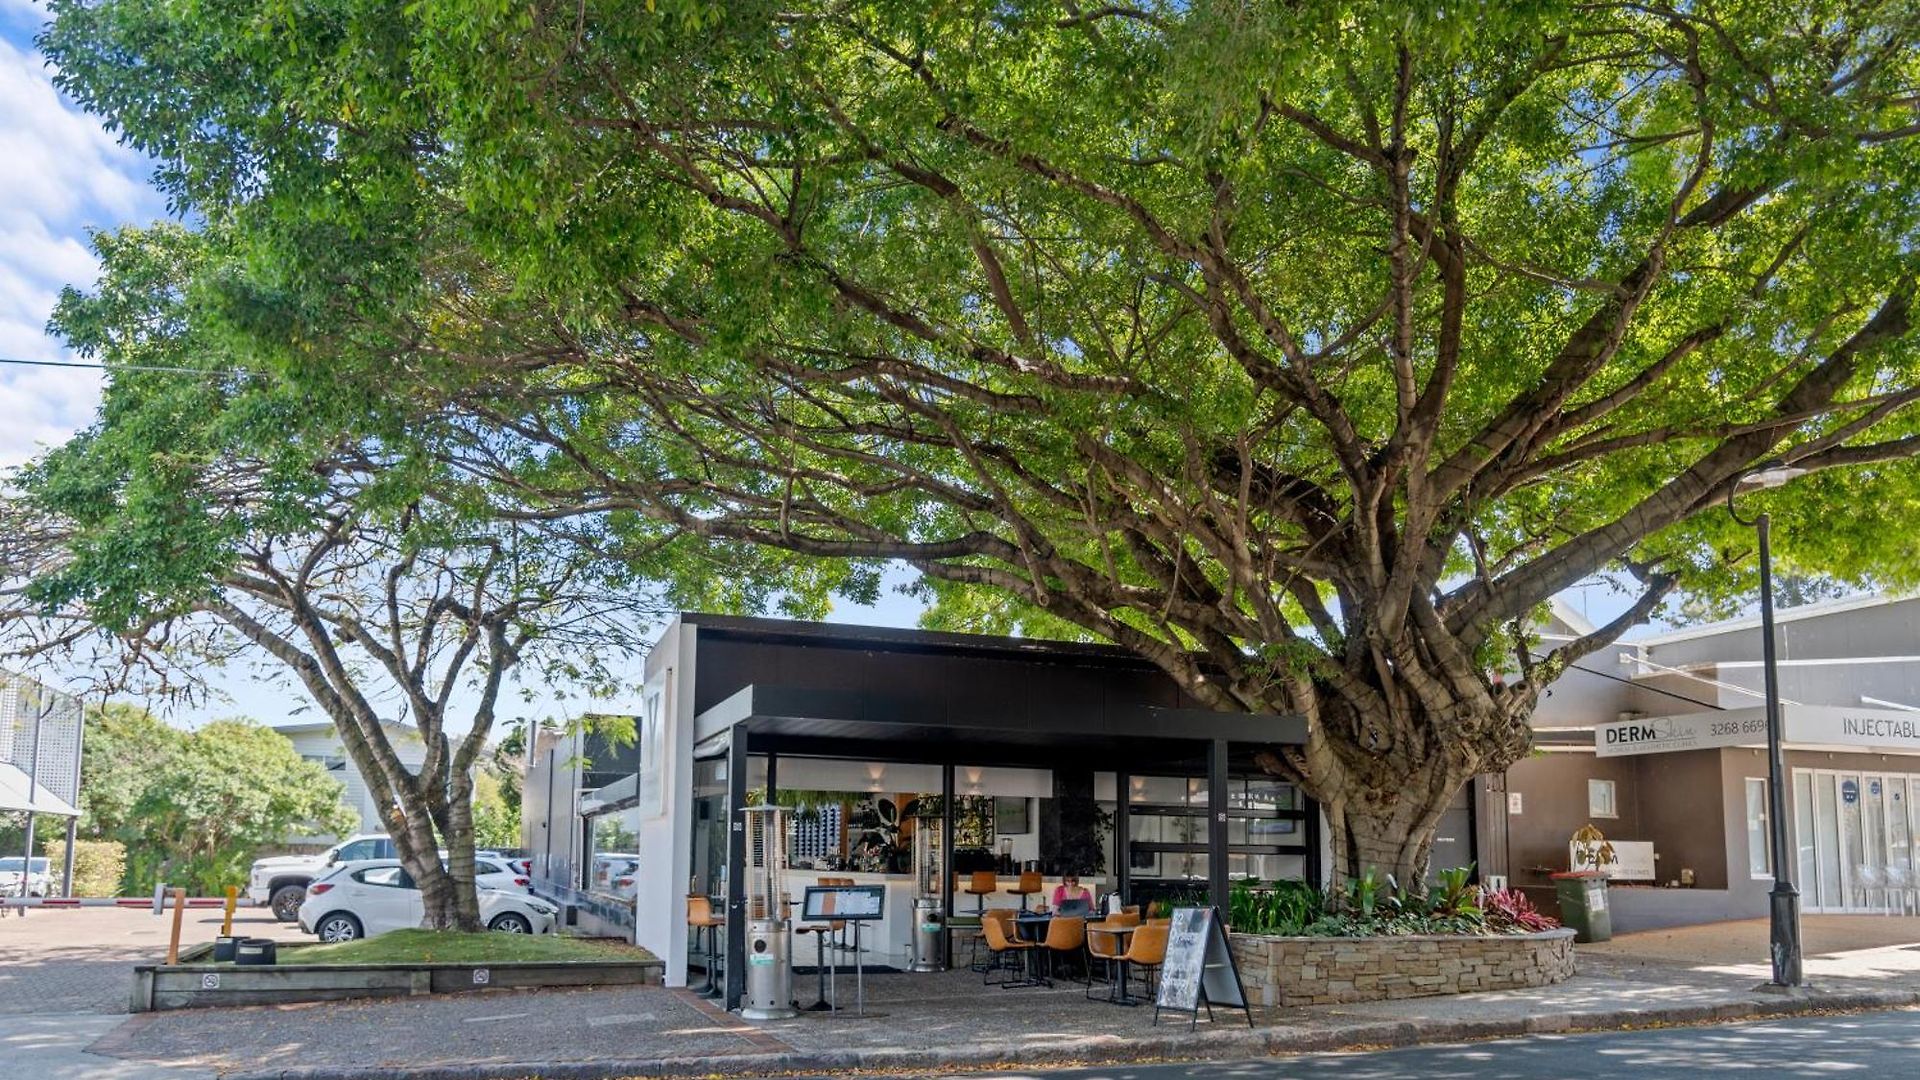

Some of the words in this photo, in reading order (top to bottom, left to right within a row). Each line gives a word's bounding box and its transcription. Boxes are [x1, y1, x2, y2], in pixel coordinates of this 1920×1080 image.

[1606, 725, 1656, 744] DERM
[1711, 722, 1739, 736] 3268
[1843, 719, 1920, 738] INJECTABL
